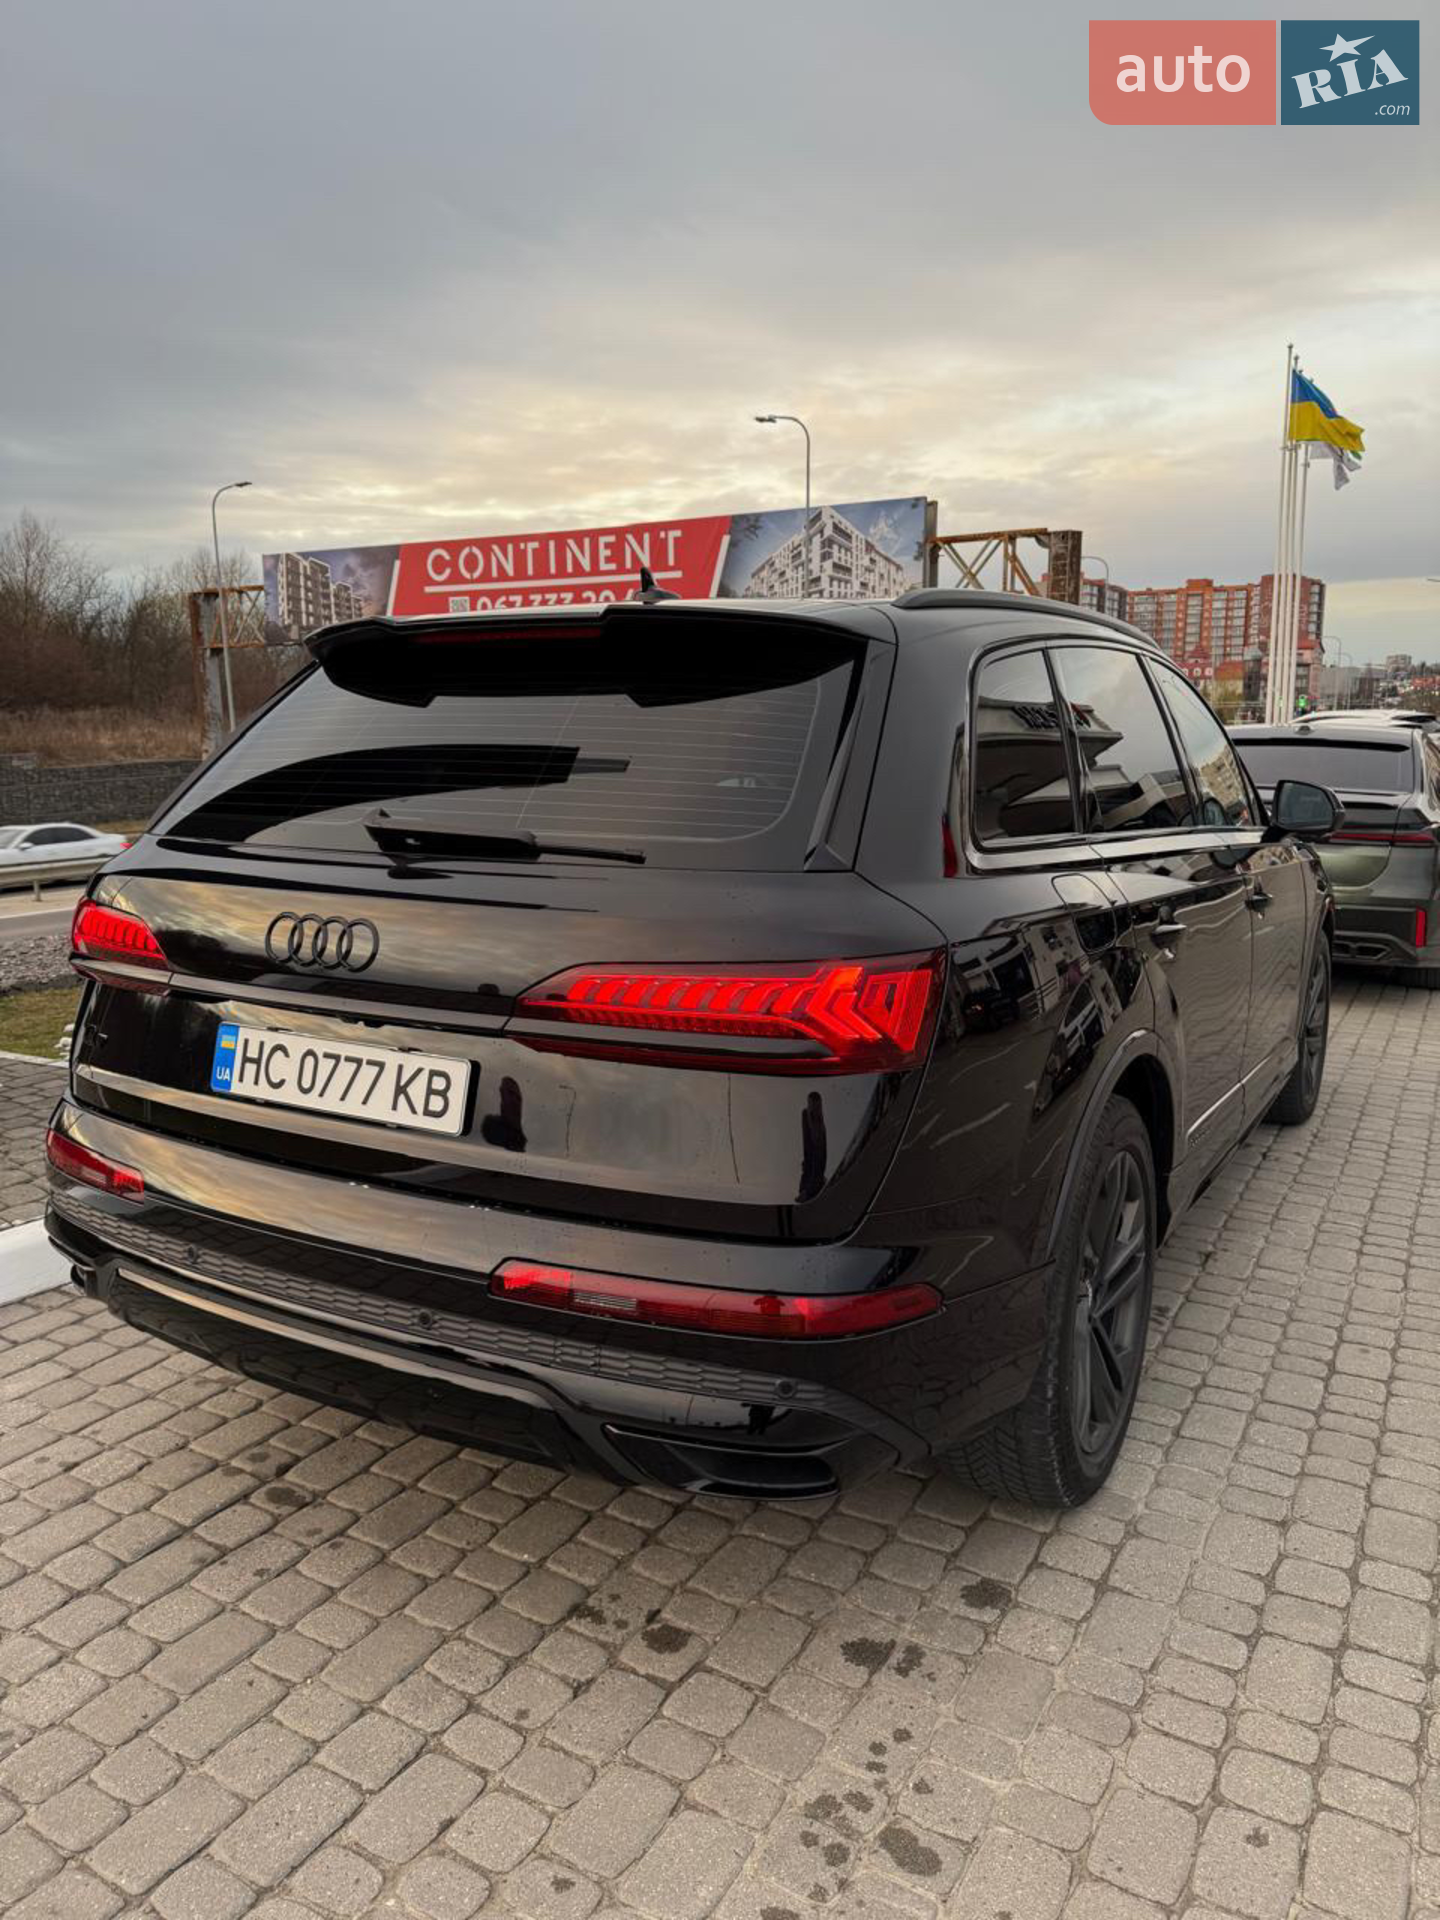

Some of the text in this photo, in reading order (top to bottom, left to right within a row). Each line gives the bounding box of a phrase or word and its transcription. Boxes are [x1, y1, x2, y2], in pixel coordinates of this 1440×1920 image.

[426, 530, 683, 582] CONTINENT
[215, 1066, 231, 1082] UA
[238, 1038, 452, 1119] HC 0777 KB
